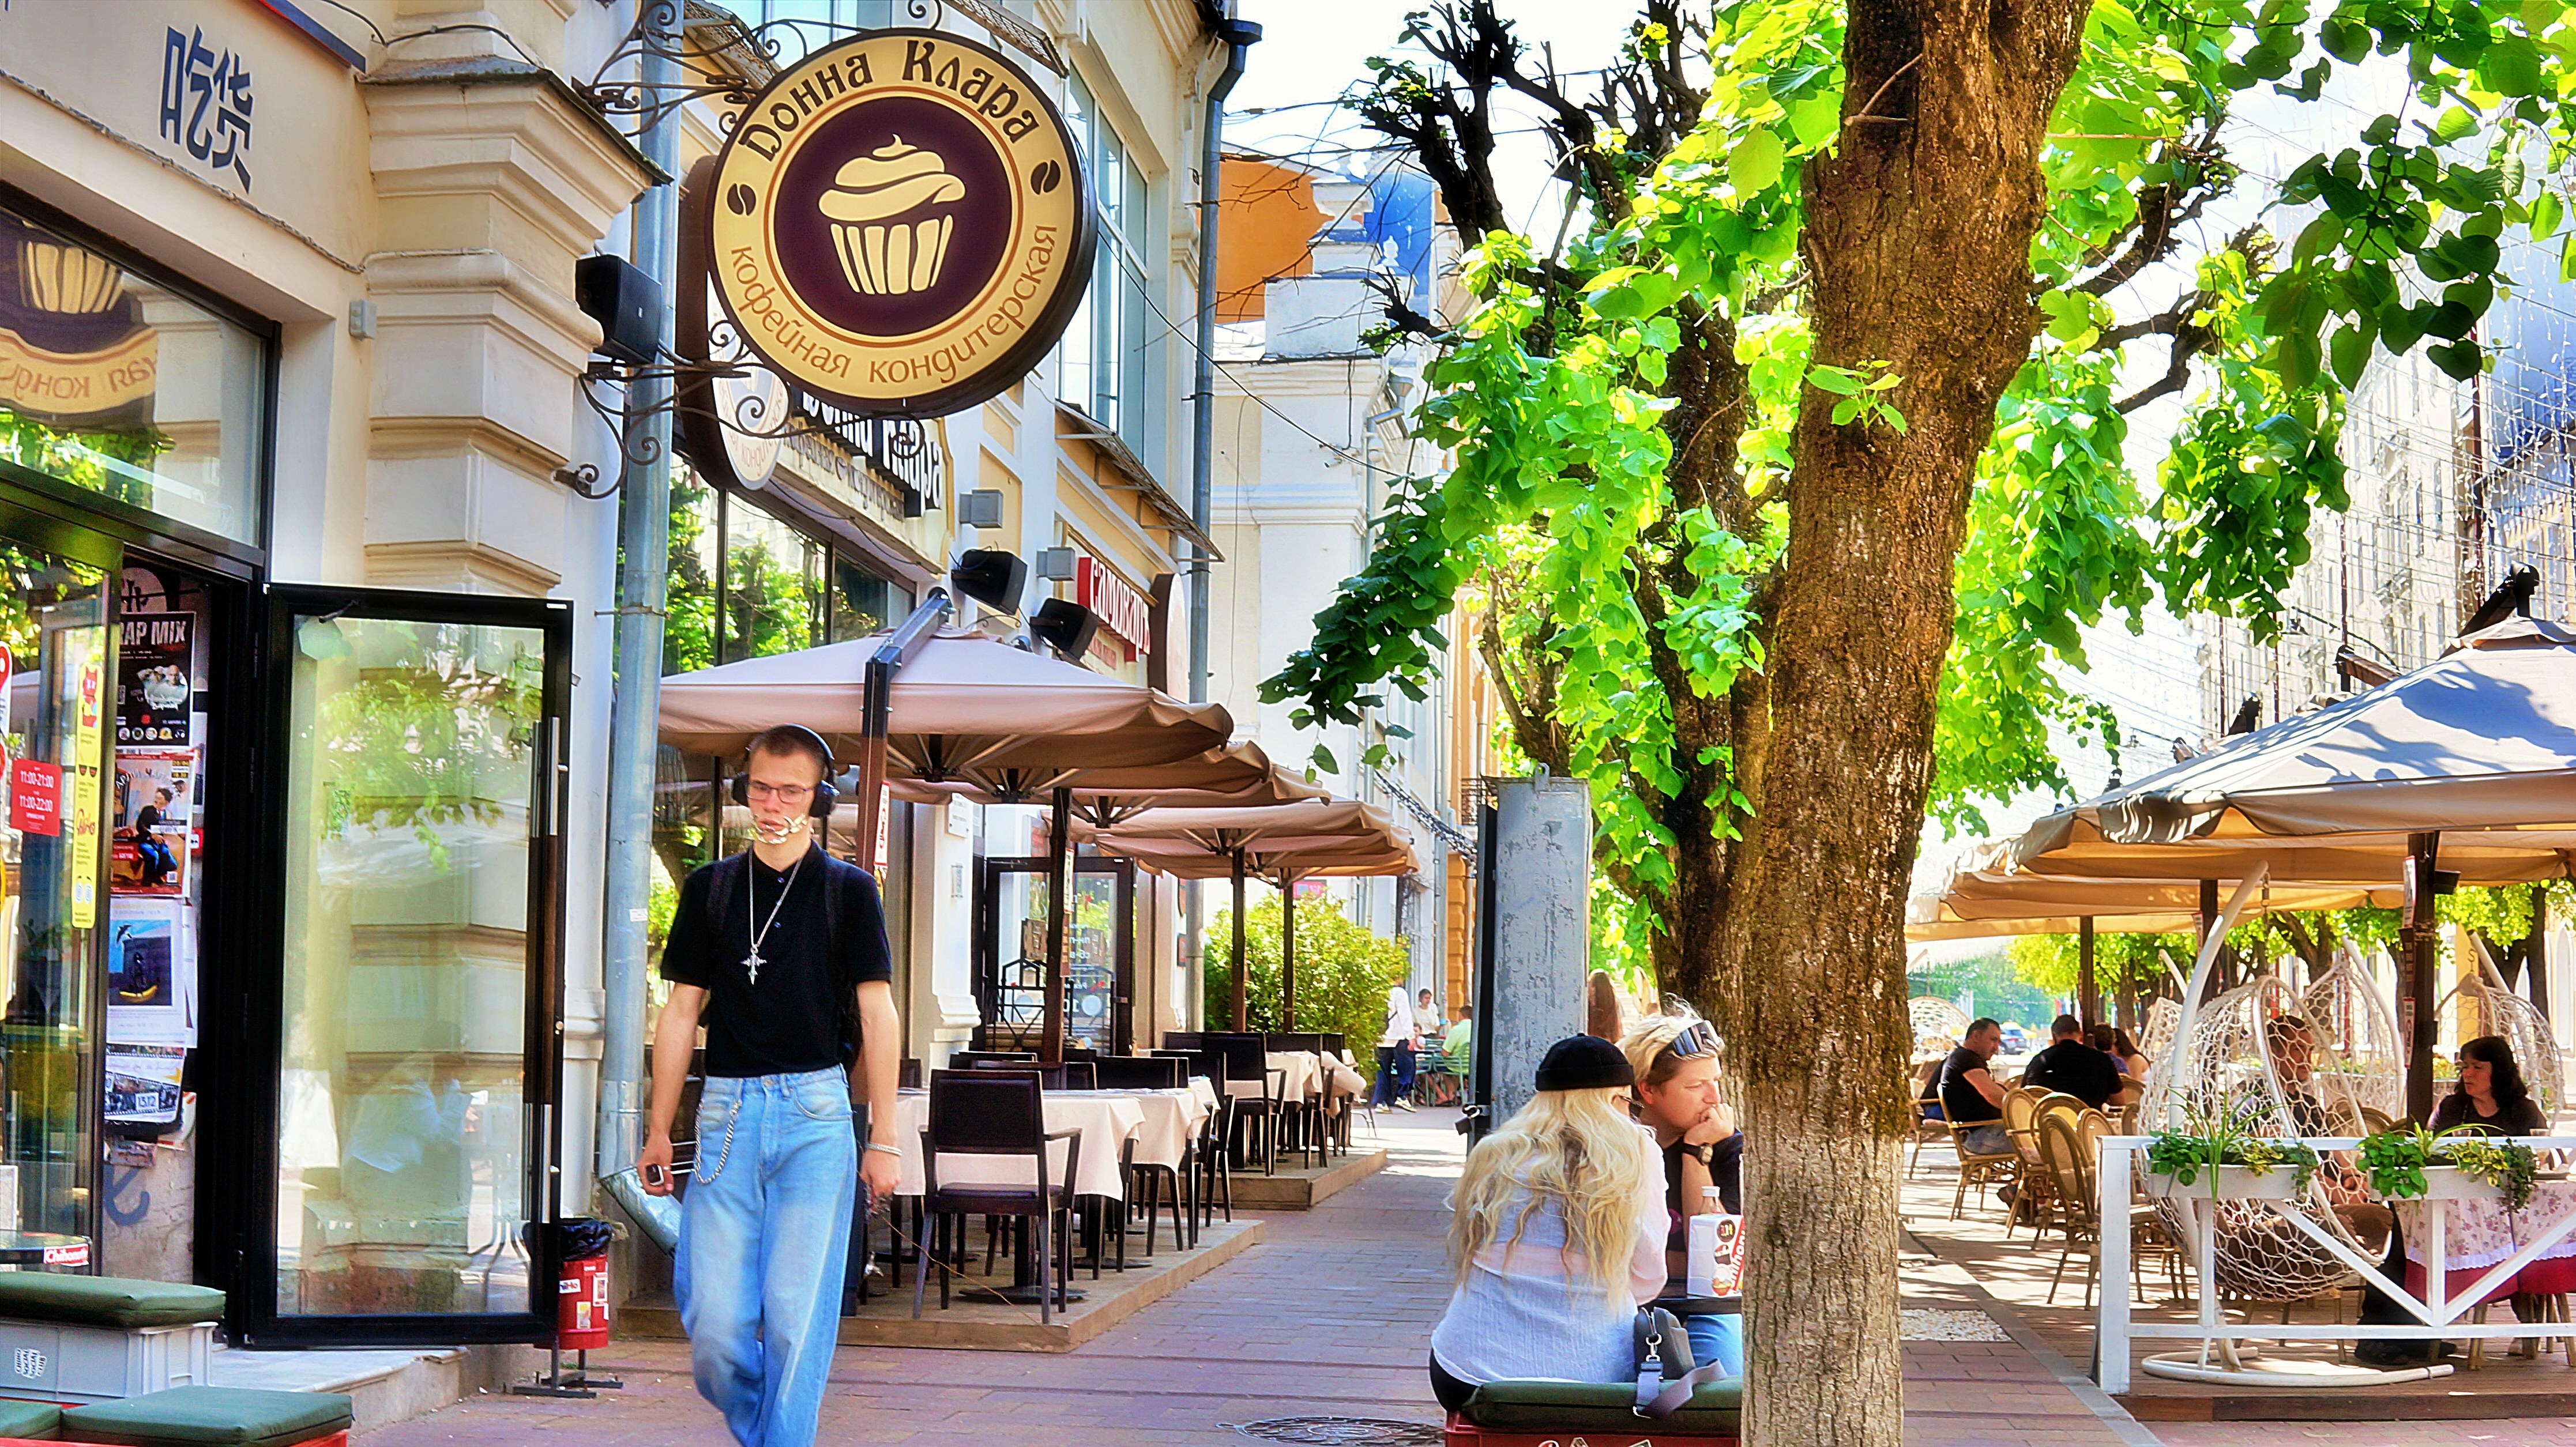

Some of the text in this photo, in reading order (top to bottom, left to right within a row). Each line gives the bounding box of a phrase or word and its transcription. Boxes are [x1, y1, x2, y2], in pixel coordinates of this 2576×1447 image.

[160, 24, 254, 194] 吃货
[739, 40, 1039, 163] Донна Клара
[731, 225, 1058, 383] кофейная кондитерская
[151, 621, 187, 646] MIX
[19, 795, 54, 813] 11:00-22:00
[20, 770, 54, 789] 11:00-21:00
